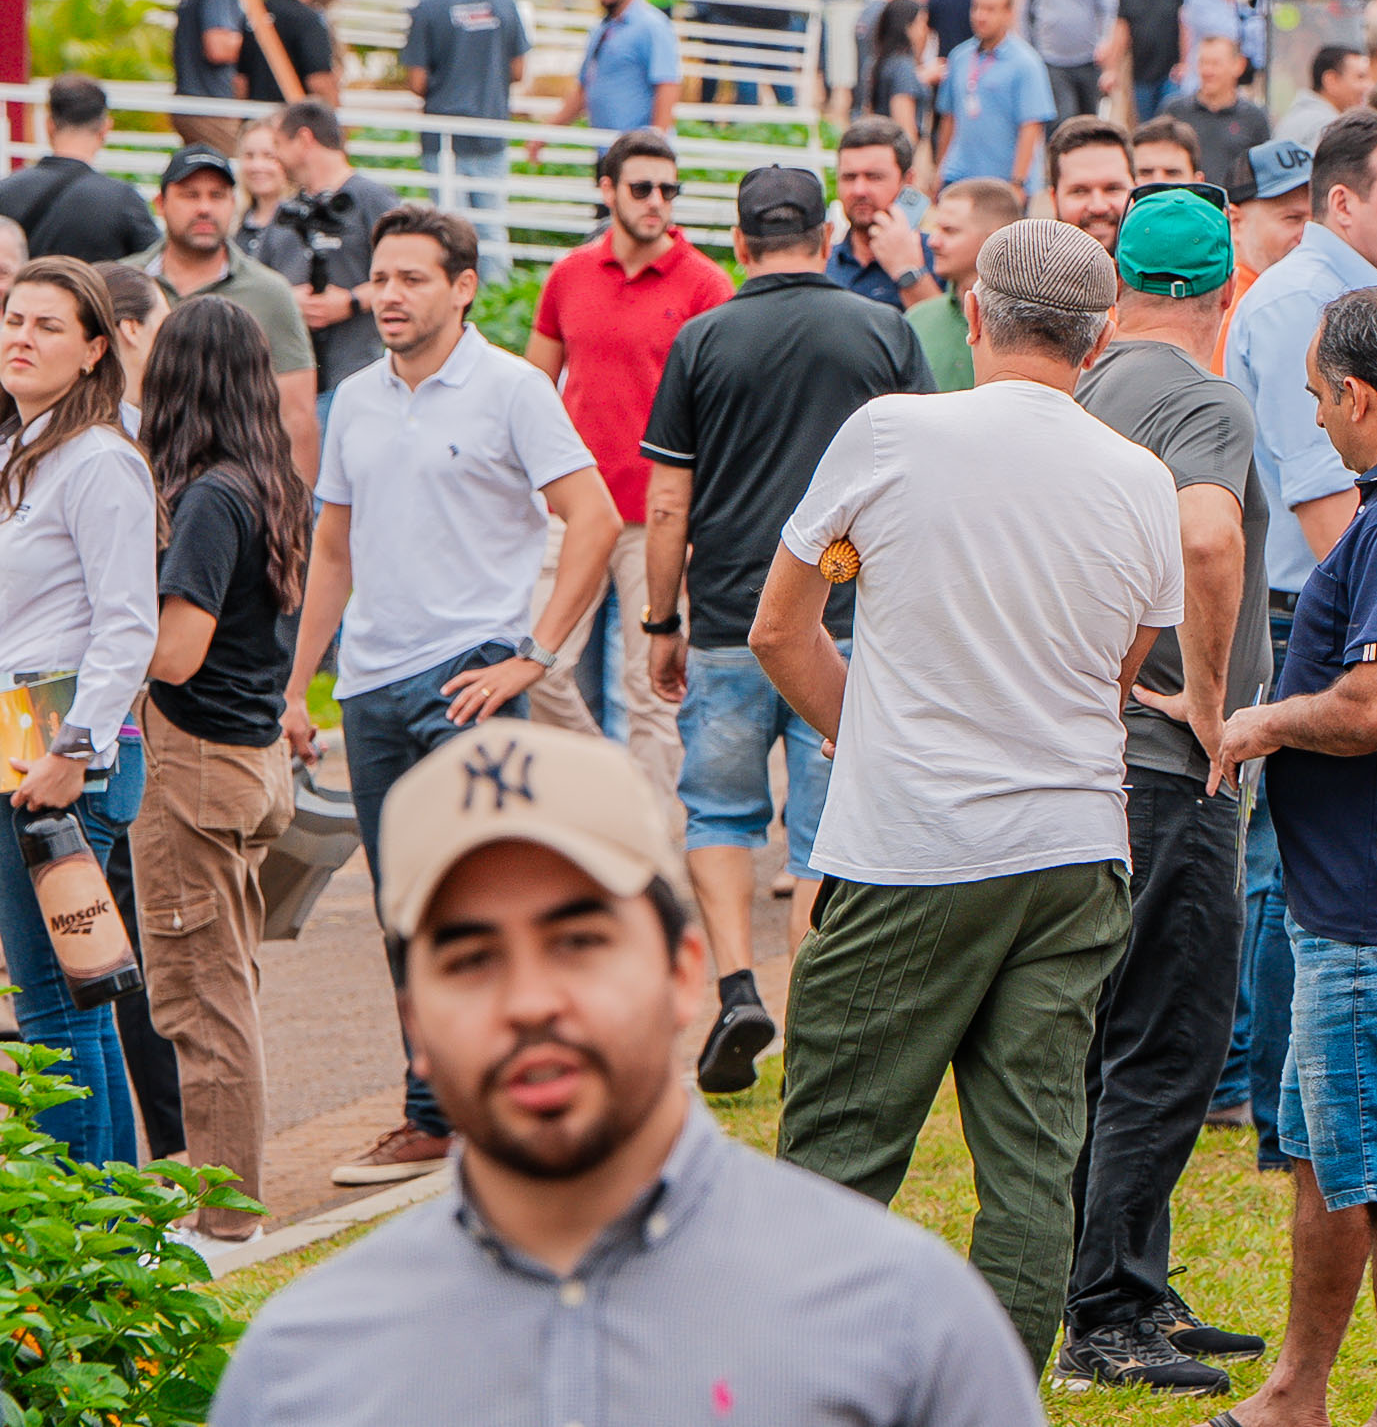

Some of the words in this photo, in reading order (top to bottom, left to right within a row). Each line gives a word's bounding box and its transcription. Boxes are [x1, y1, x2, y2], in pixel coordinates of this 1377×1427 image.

[1275, 149, 1312, 170] UP
[463, 739, 535, 811] NY
[49, 899, 110, 932] Mosaic
